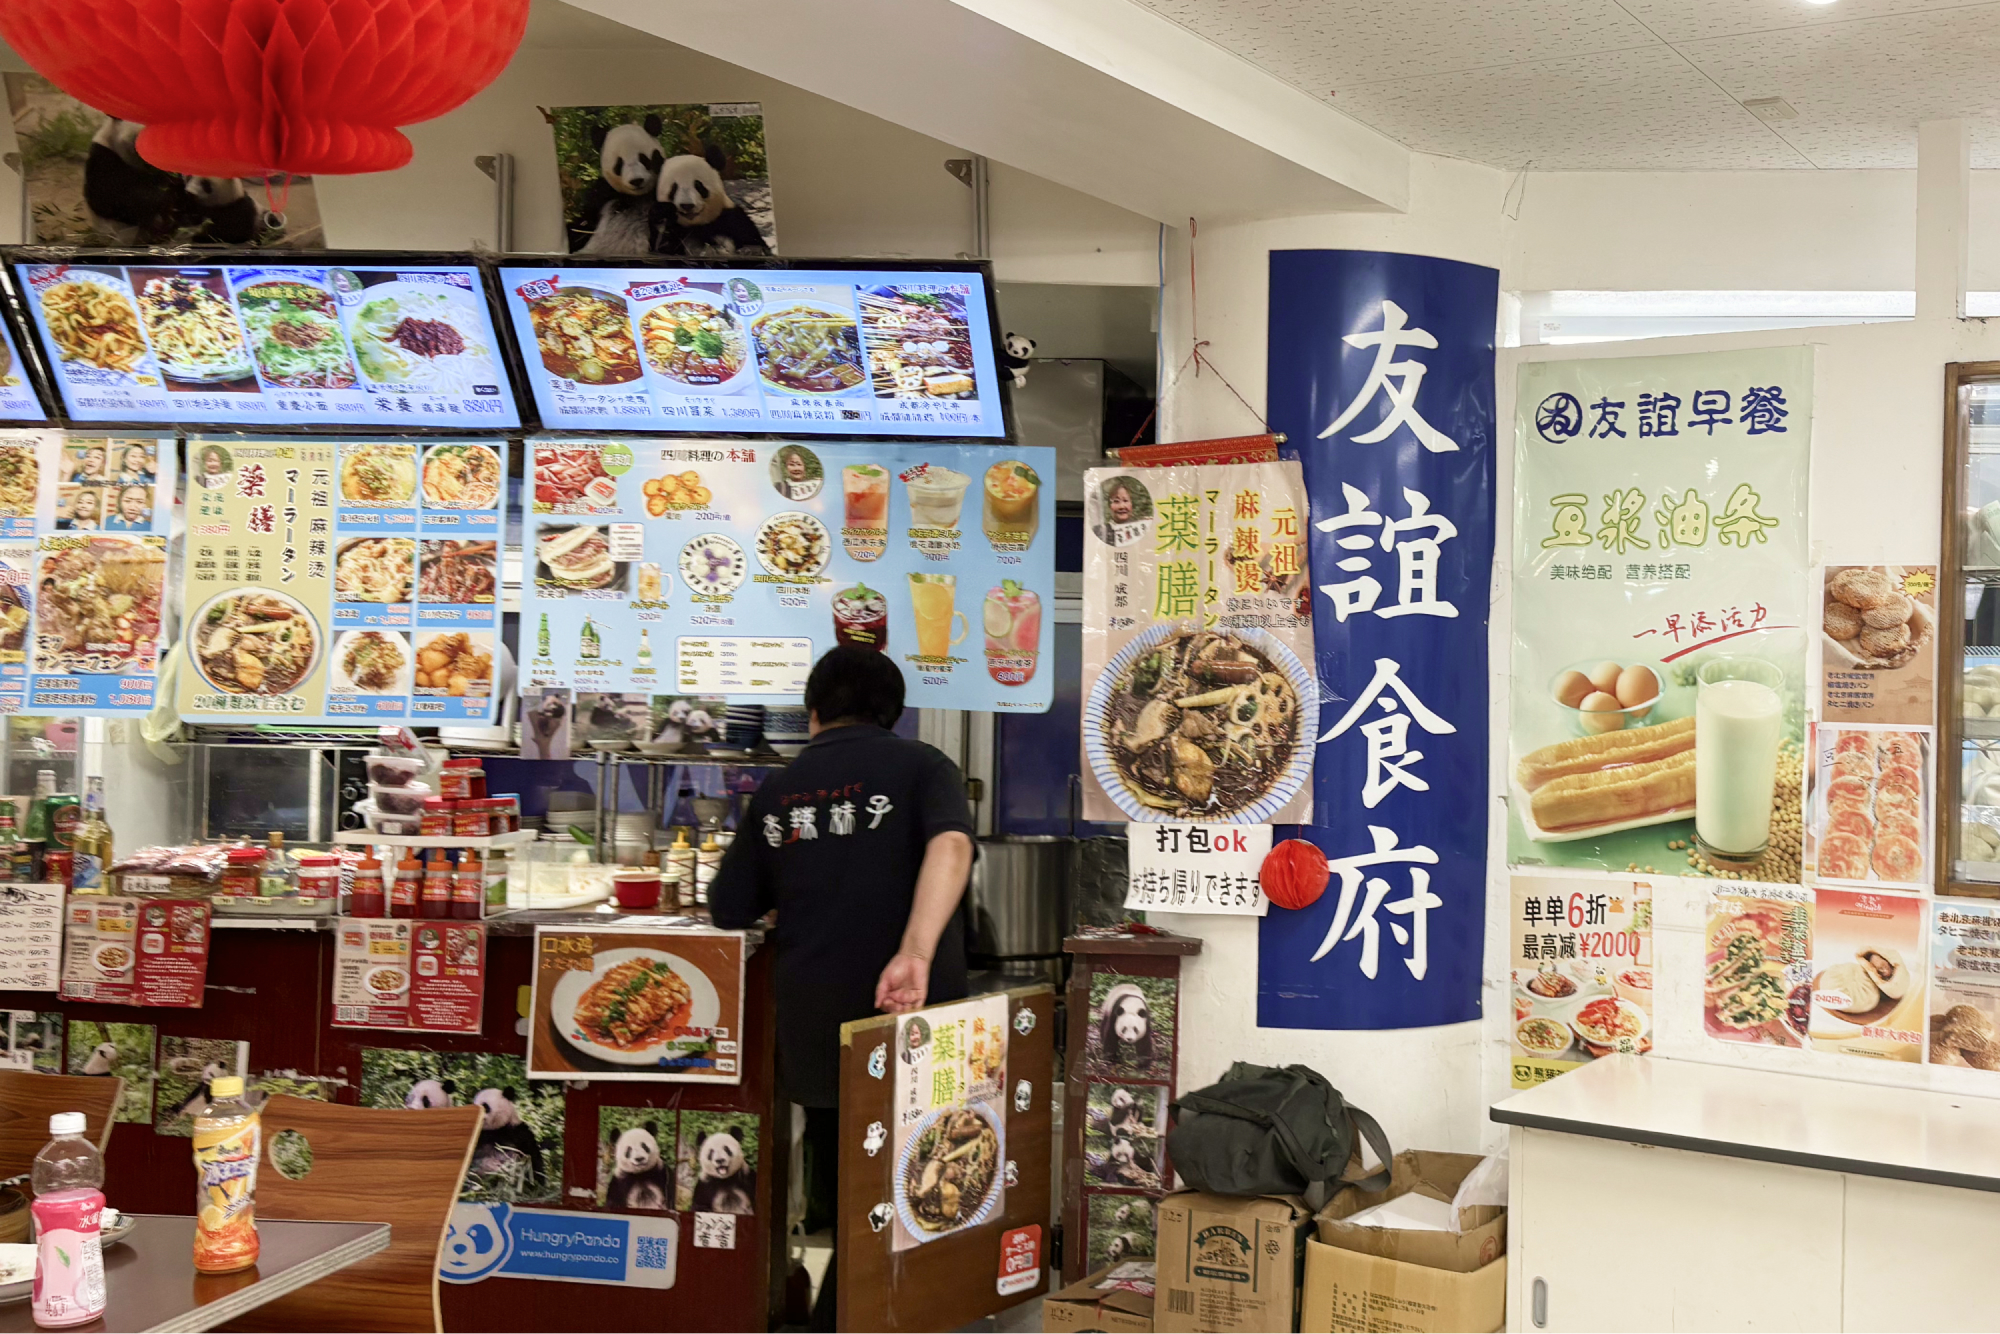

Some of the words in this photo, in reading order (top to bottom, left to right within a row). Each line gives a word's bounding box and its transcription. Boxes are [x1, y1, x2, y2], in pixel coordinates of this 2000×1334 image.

[1588, 384, 1790, 440] 友誼早餐
[280, 468, 300, 584] マーラータン
[1271, 506, 1300, 576] 元祖
[1540, 482, 1780, 556] 豆浆油条
[1153, 494, 1201, 620] 薬膳
[1204, 489, 1221, 629] マーラータン
[1310, 300, 1461, 982] 友誼食府
[1632, 601, 1769, 643] 一早添活力
[1155, 824, 1249, 854] 打包ok
[1522, 891, 1608, 929] 单单6折
[931, 1023, 957, 1109] 薬膳
[519, 1249, 620, 1265] www.hungrypanda.co
[520, 1227, 622, 1249] HungryPanda
